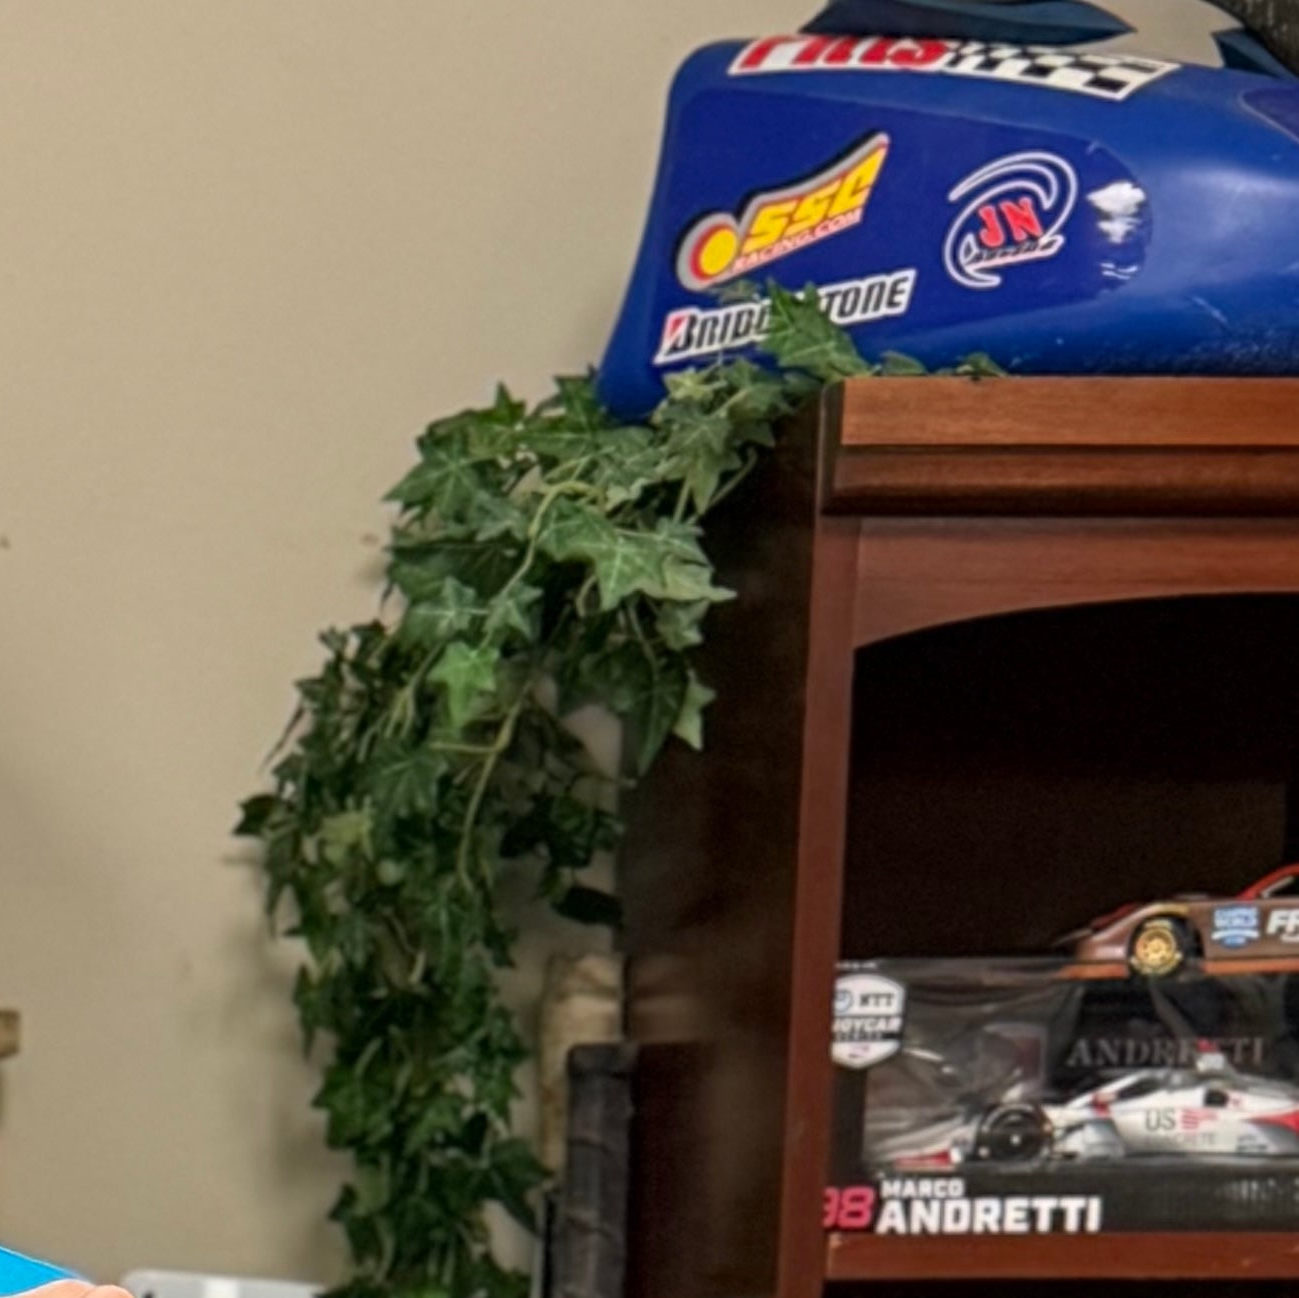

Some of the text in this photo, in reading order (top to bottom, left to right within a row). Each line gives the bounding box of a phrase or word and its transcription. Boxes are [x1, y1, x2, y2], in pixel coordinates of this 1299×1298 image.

[978, 197, 1043, 248] JN
[664, 275, 910, 357] BRIDTONE
[1067, 1037, 1265, 1067] ANDRETI
[880, 1178, 965, 1198] MARCO
[876, 1196, 1102, 1234] ANDRETTI
